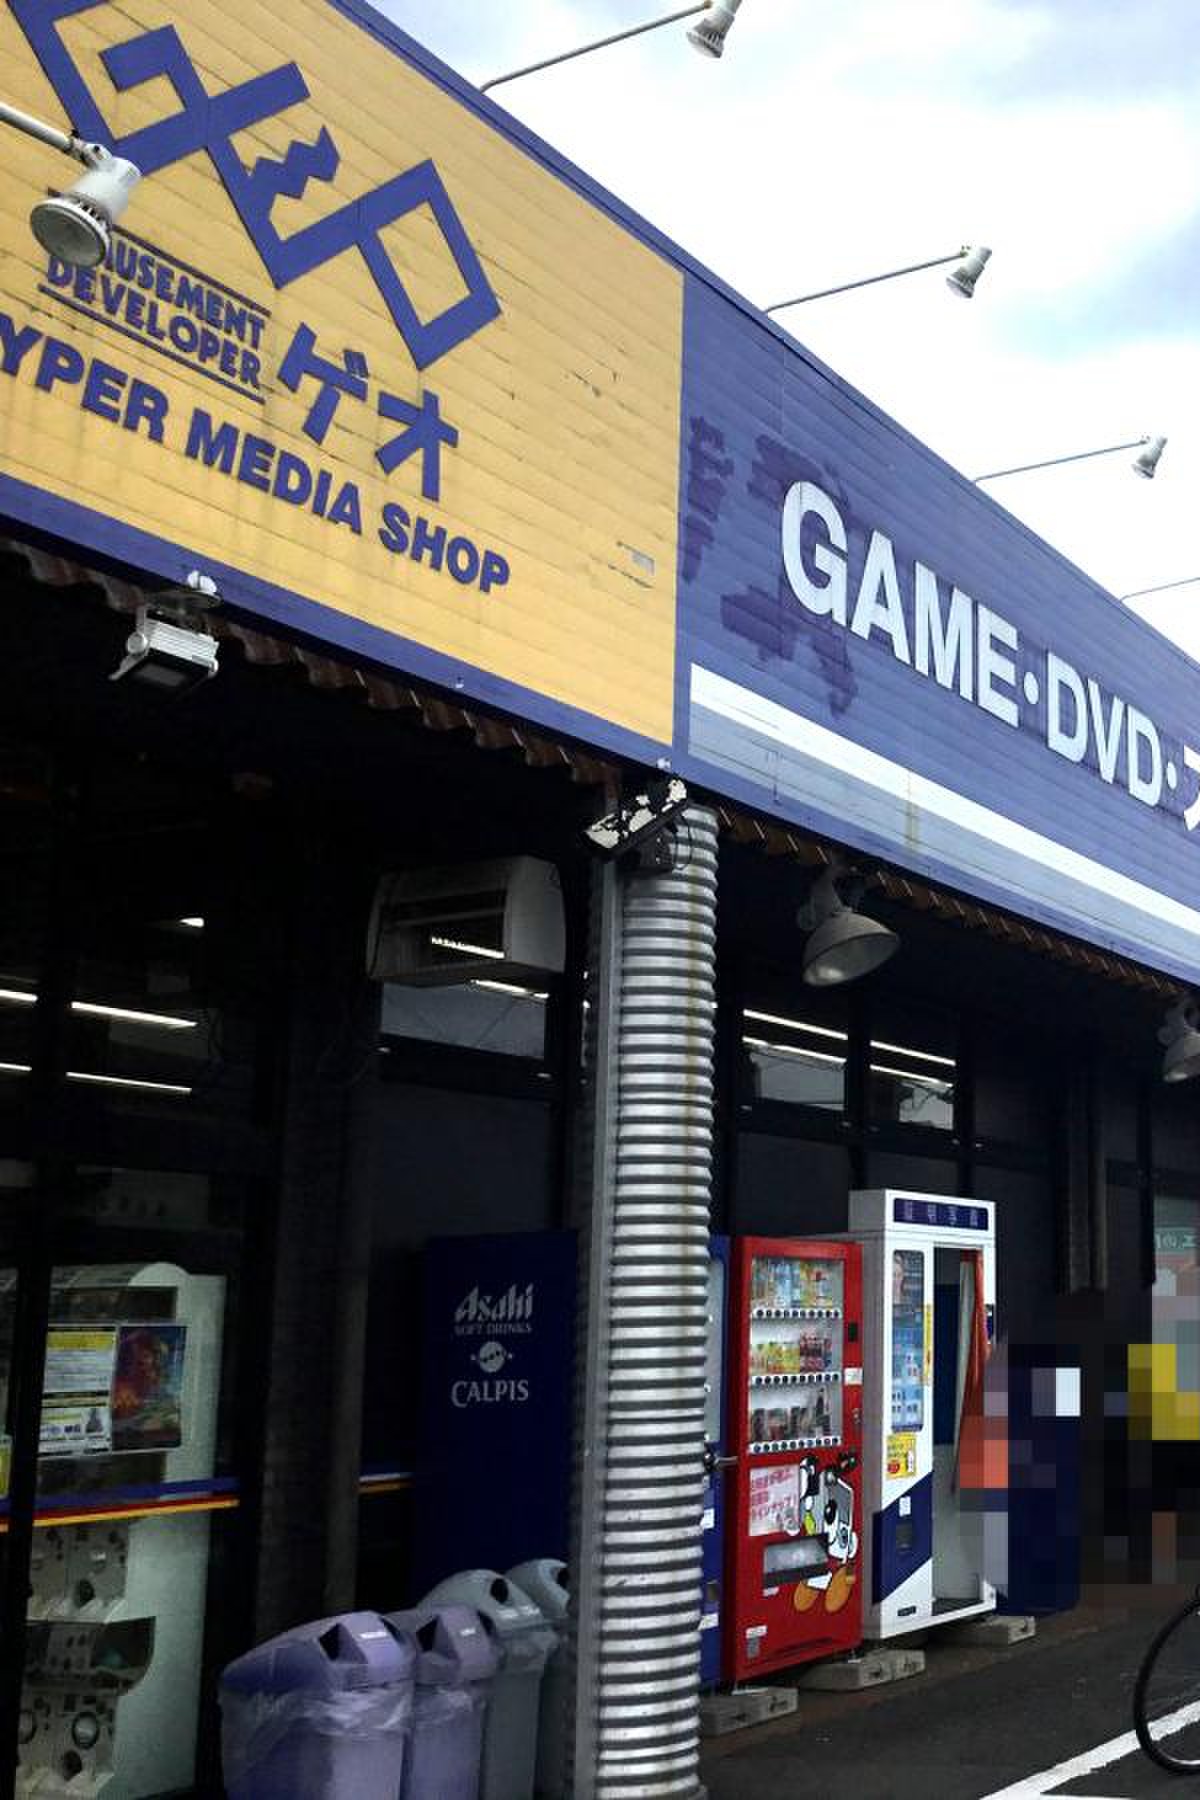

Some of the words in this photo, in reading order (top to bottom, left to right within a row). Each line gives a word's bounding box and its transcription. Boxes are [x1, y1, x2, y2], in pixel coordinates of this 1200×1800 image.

[47, 255, 262, 390] DEVELOPER
[103, 236, 266, 351] USEMENT
[277, 321, 458, 501] ゲオ
[184, 408, 363, 535] MEDIA
[378, 503, 511, 593] SHOP
[455, 1283, 534, 1322] Asahi
[451, 1379, 529, 1408] CALPIS
